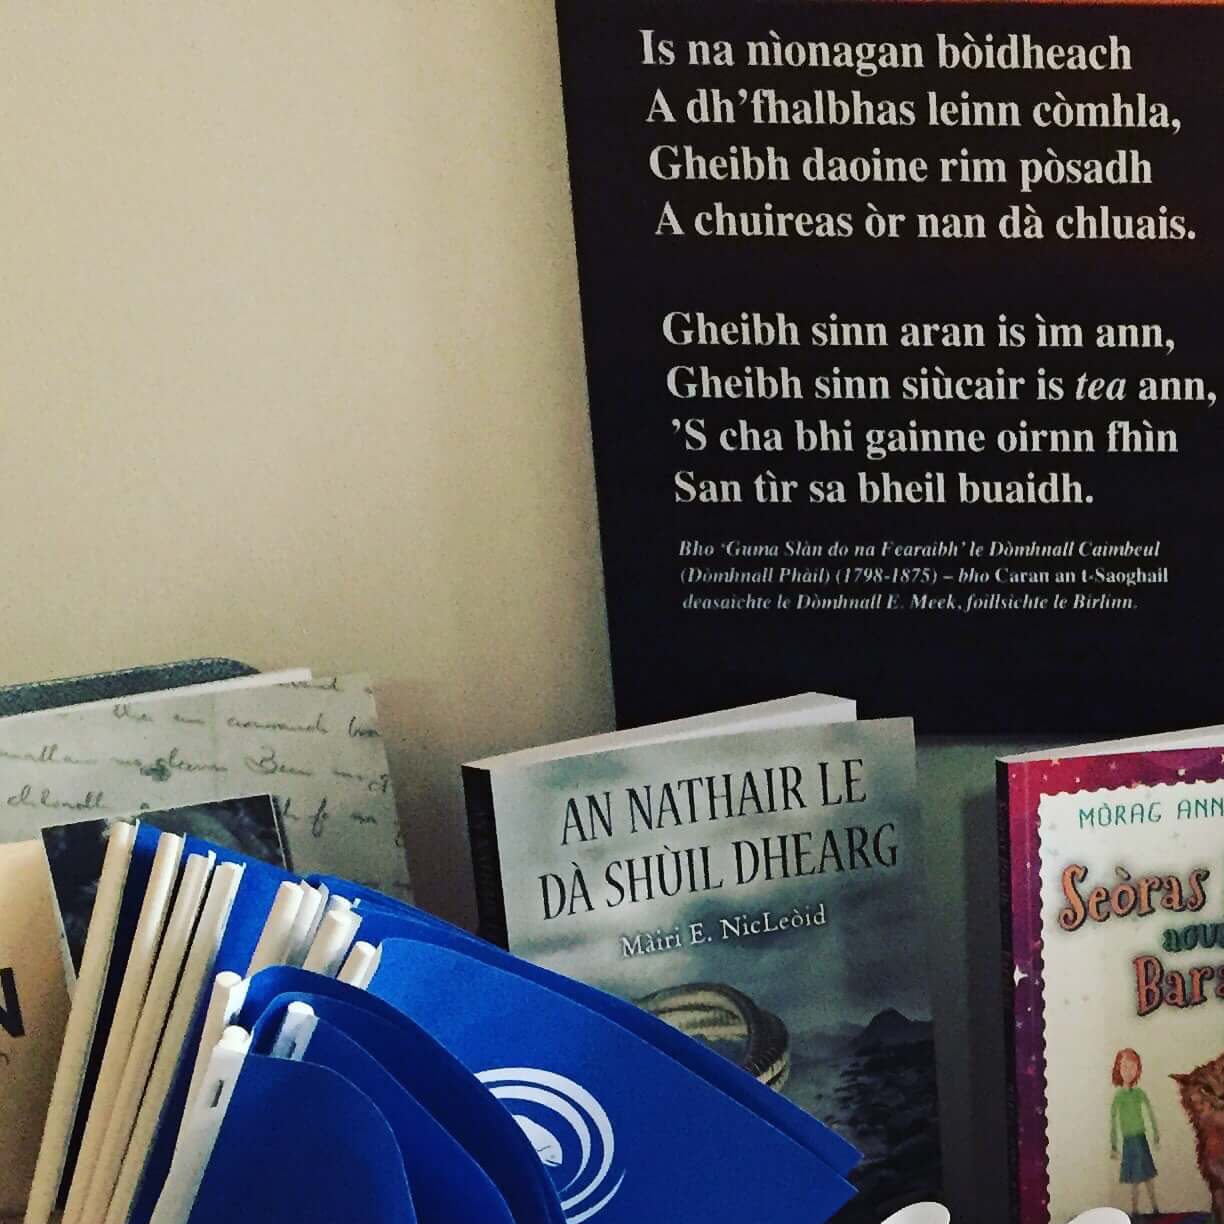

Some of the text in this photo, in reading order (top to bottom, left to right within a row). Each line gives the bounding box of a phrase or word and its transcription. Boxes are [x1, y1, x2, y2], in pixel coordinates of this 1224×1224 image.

[640, 29, 1132, 77] Is na nìonagan bòidheach
[646, 89, 1180, 132] A dh'fhalbhas leinn còmhla,
[675, 470, 1093, 503] San tìr sa bheil buaidh.
[561, 758, 867, 845] AN NATHAIR LE
[1078, 802, 1162, 829] MÒRAG
[538, 823, 899, 920] DÀ SHÙIL DHEARG
[1058, 864, 1210, 932] Seòras
[621, 903, 827, 958] Màiri E. NicLeòid
